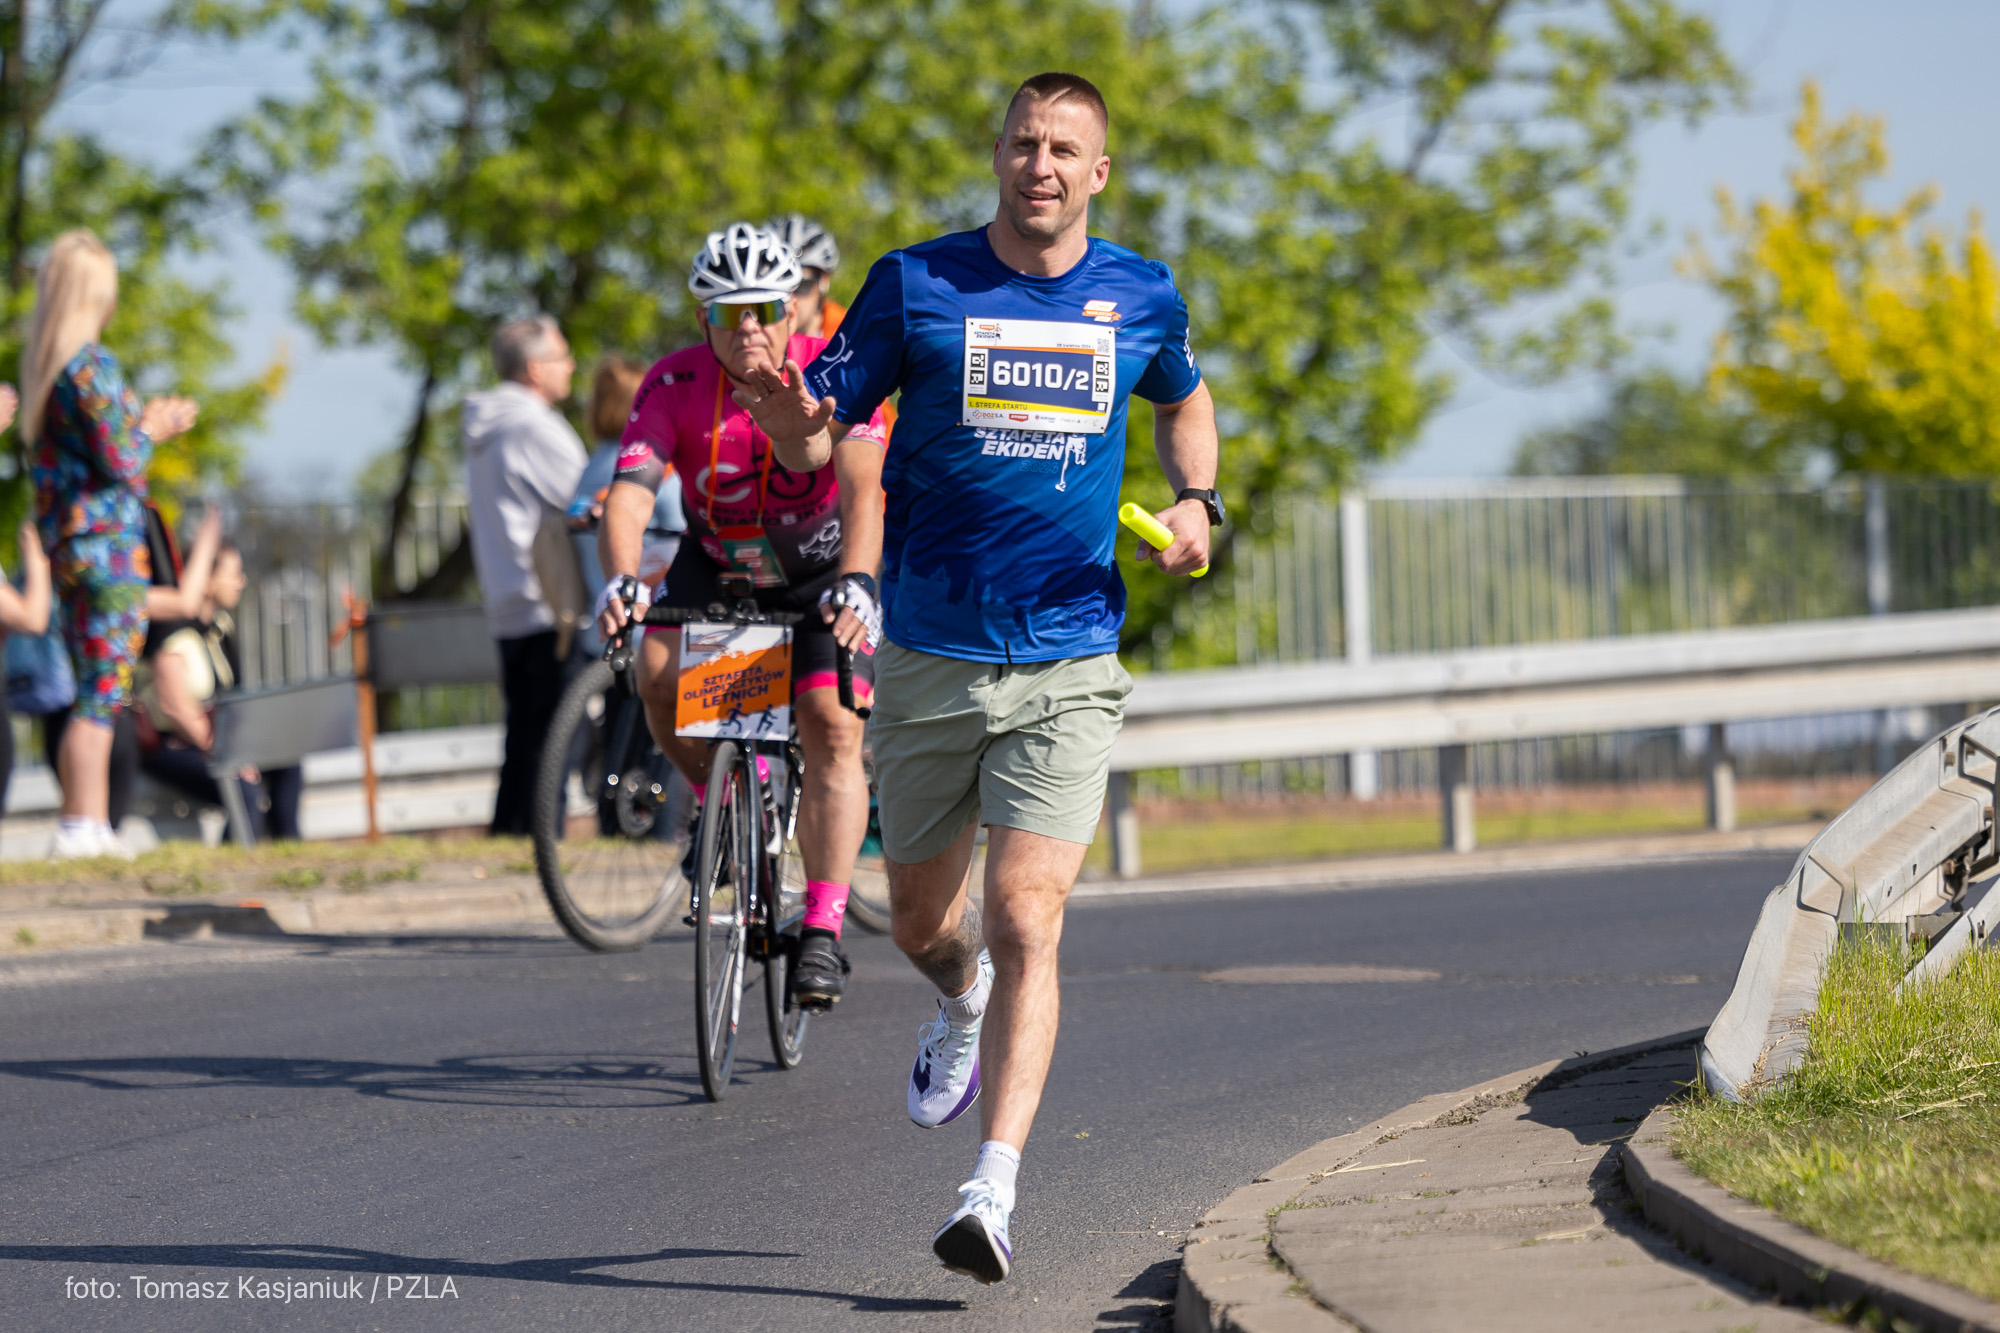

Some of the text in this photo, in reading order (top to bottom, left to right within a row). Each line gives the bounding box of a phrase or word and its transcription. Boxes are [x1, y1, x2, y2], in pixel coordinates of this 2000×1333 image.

[992, 360, 1090, 391] 6010/2
[1002, 403, 1028, 411] STARTU
[973, 427, 1066, 445] SZTAFETA
[981, 440, 1065, 461] EKIDEN
[1019, 460, 1059, 474] 2024
[683, 669, 786, 701] OLIMPIJCZYKÓW
[703, 666, 763, 687] SZTAFETA
[702, 684, 769, 709] LETNICH
